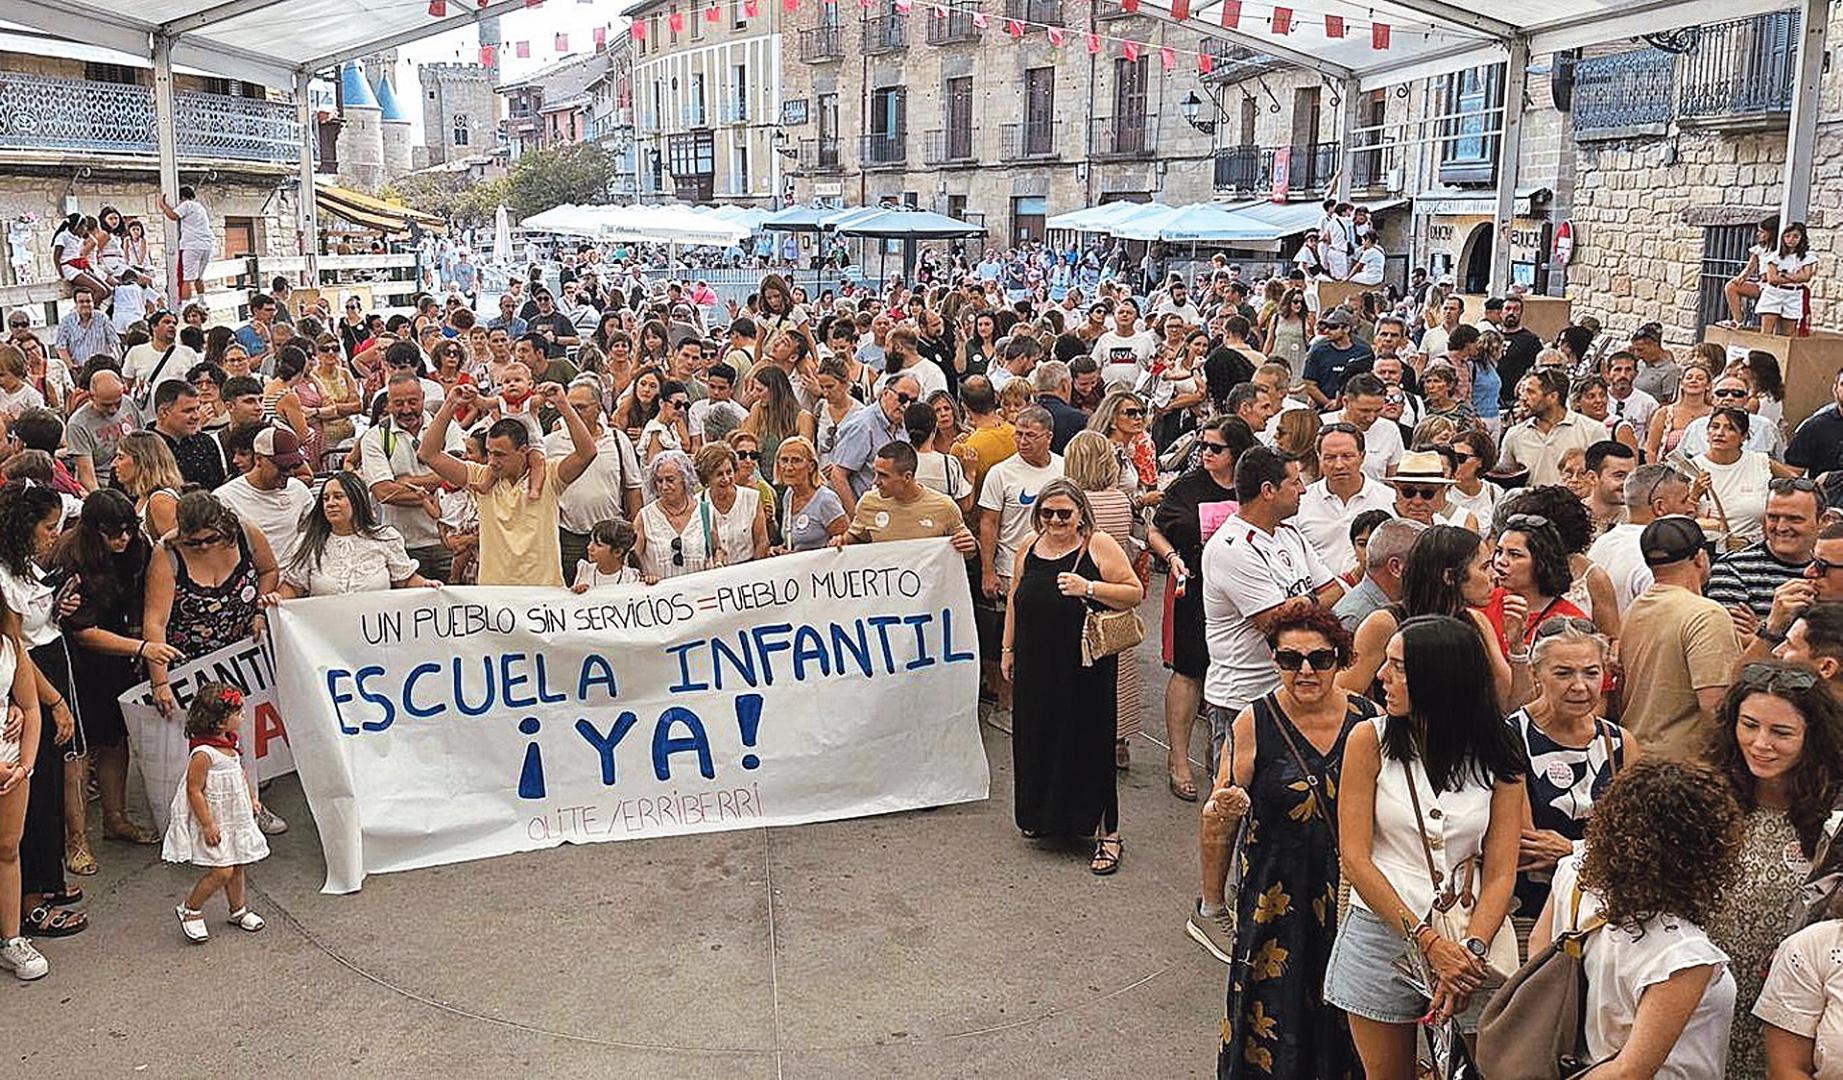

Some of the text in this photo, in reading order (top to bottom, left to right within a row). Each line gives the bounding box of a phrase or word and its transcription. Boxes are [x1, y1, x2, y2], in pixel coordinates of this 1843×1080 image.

[361, 610, 402, 645] UN
[414, 604, 516, 638] PUEBLO
[811, 566, 921, 600] MUERTO
[326, 607, 975, 735] ESCUELA INFANTIL
